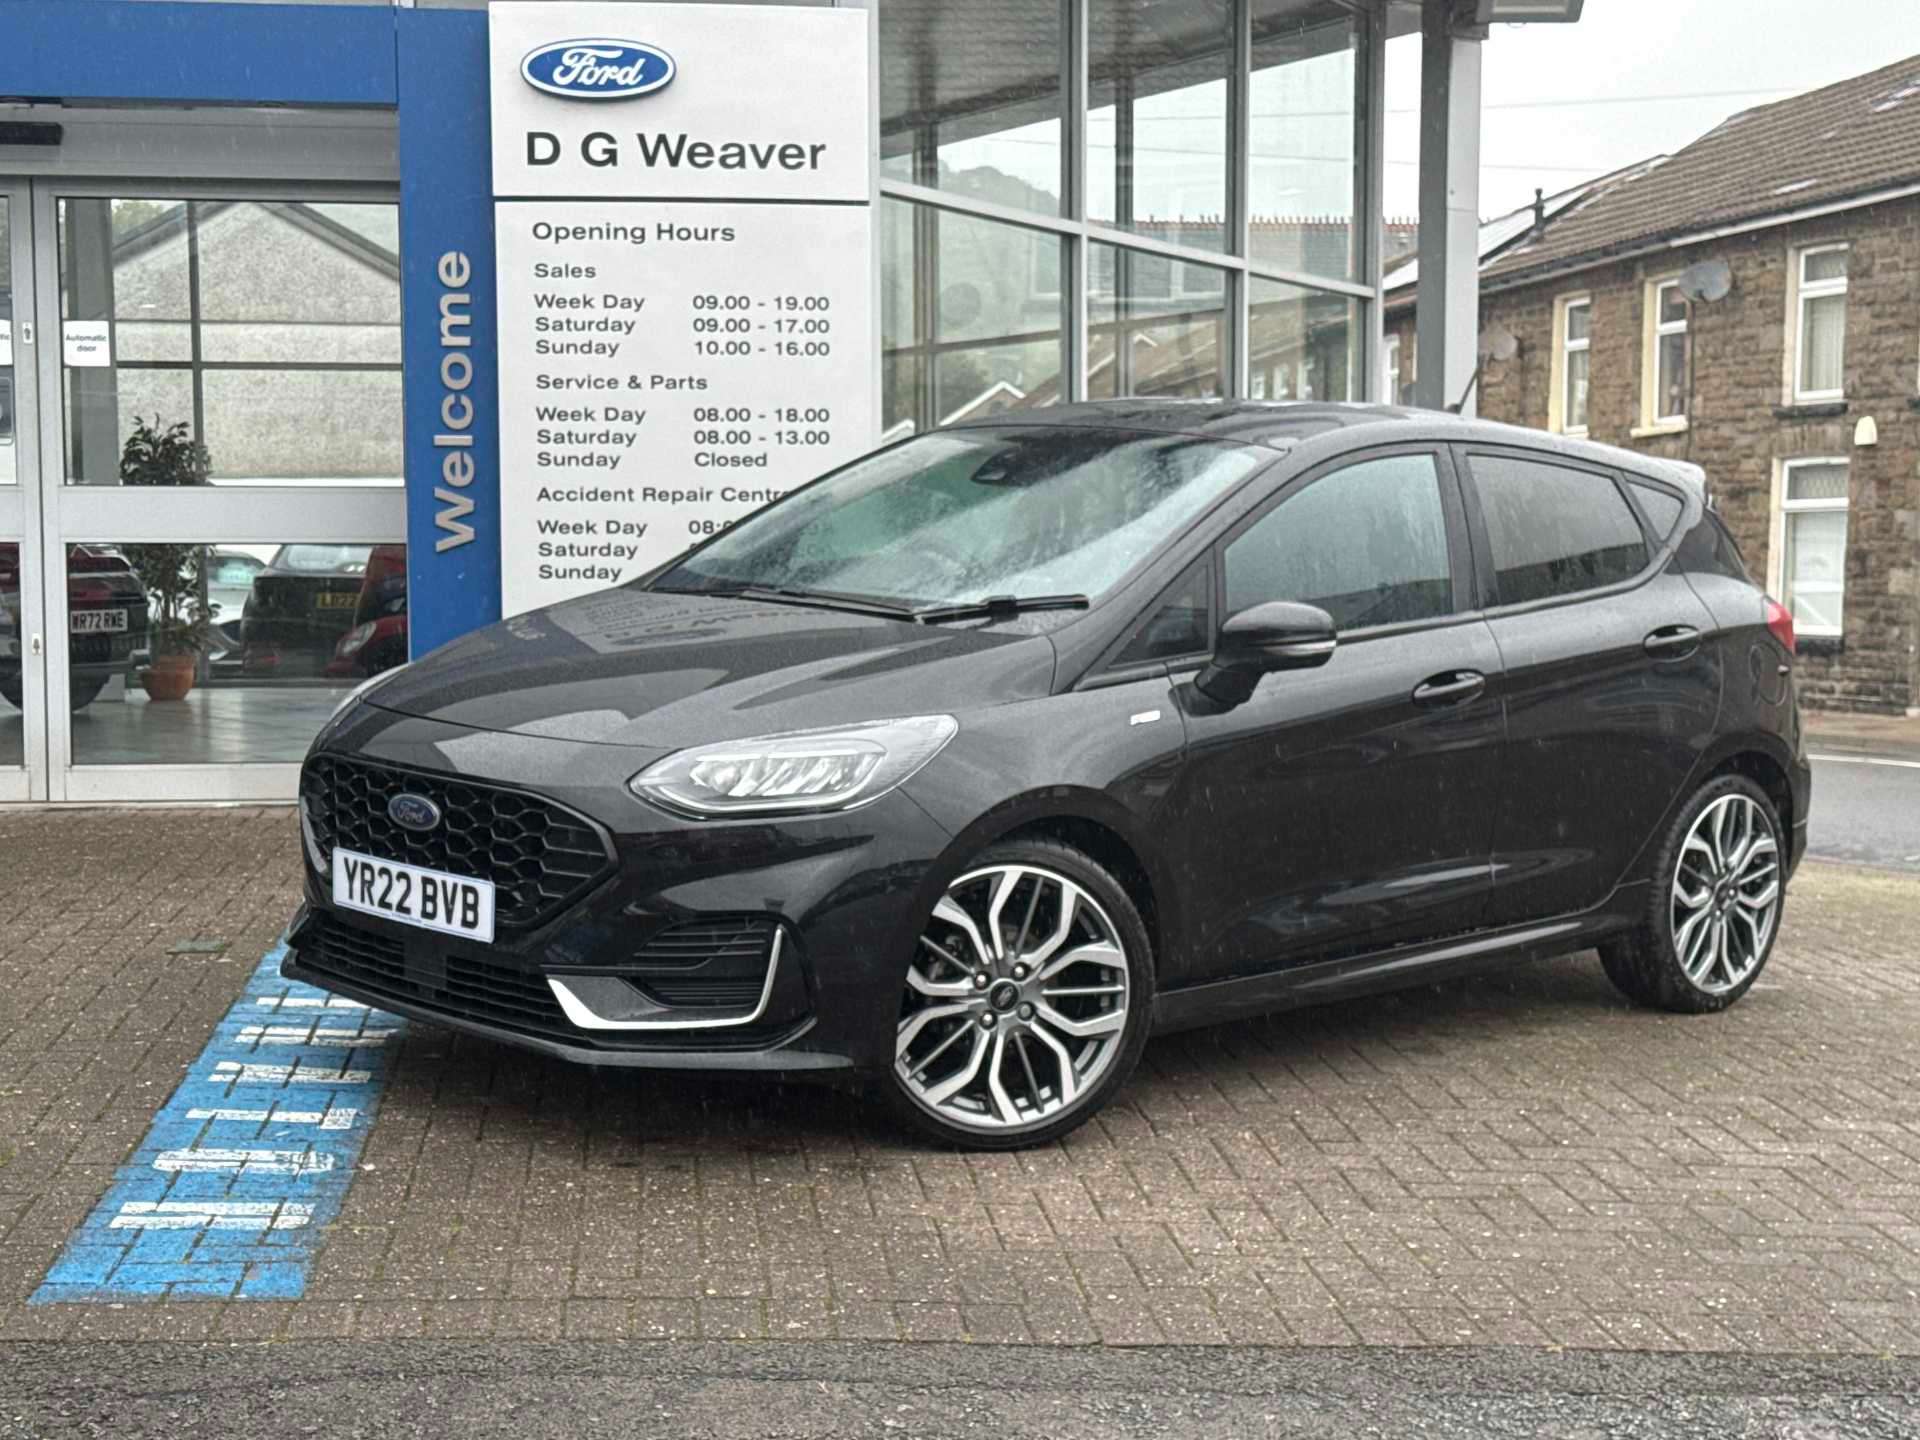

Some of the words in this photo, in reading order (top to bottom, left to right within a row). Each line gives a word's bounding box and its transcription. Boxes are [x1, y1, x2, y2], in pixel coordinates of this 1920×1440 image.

[553, 48, 644, 86] Ford
[527, 132, 560, 165] D
[581, 132, 617, 167] G
[637, 133, 826, 170] Weaver
[533, 222, 645, 244] Opening
[657, 223, 735, 241] Hours
[535, 263, 596, 278] Sales
[534, 294, 594, 309] Week
[603, 295, 644, 312] Day
[693, 295, 750, 310] 09.00
[775, 296, 829, 310] 19.00
[536, 317, 635, 335] Saturday
[693, 318, 750, 332] 09.00
[775, 319, 829, 333] 17.00
[65, 333, 107, 342] Automatic
[76, 344, 97, 352] door
[536, 339, 619, 357] Sunday
[696, 341, 750, 355] 10.00
[775, 342, 829, 356] 16.00
[536, 374, 618, 389] Service
[628, 375, 641, 389] &
[651, 375, 707, 390] Parts
[433, 251, 475, 552] Welcome
[536, 407, 595, 421] Week
[605, 407, 646, 425] Day
[694, 408, 751, 422] 08.00
[776, 408, 830, 422] 18.00
[537, 429, 636, 447] Saturday
[694, 430, 751, 444] 08.00
[776, 431, 830, 445] 13.00
[538, 452, 620, 470] Sunday
[694, 452, 767, 467] Closed
[537, 487, 634, 502] Accident
[643, 487, 713, 504] Repair
[537, 520, 597, 534] Week
[606, 520, 648, 538] Day
[538, 542, 638, 560] Saturday
[539, 564, 622, 582] Sunday
[343, 857, 412, 916] YR22
[420, 875, 480, 930] BVB
